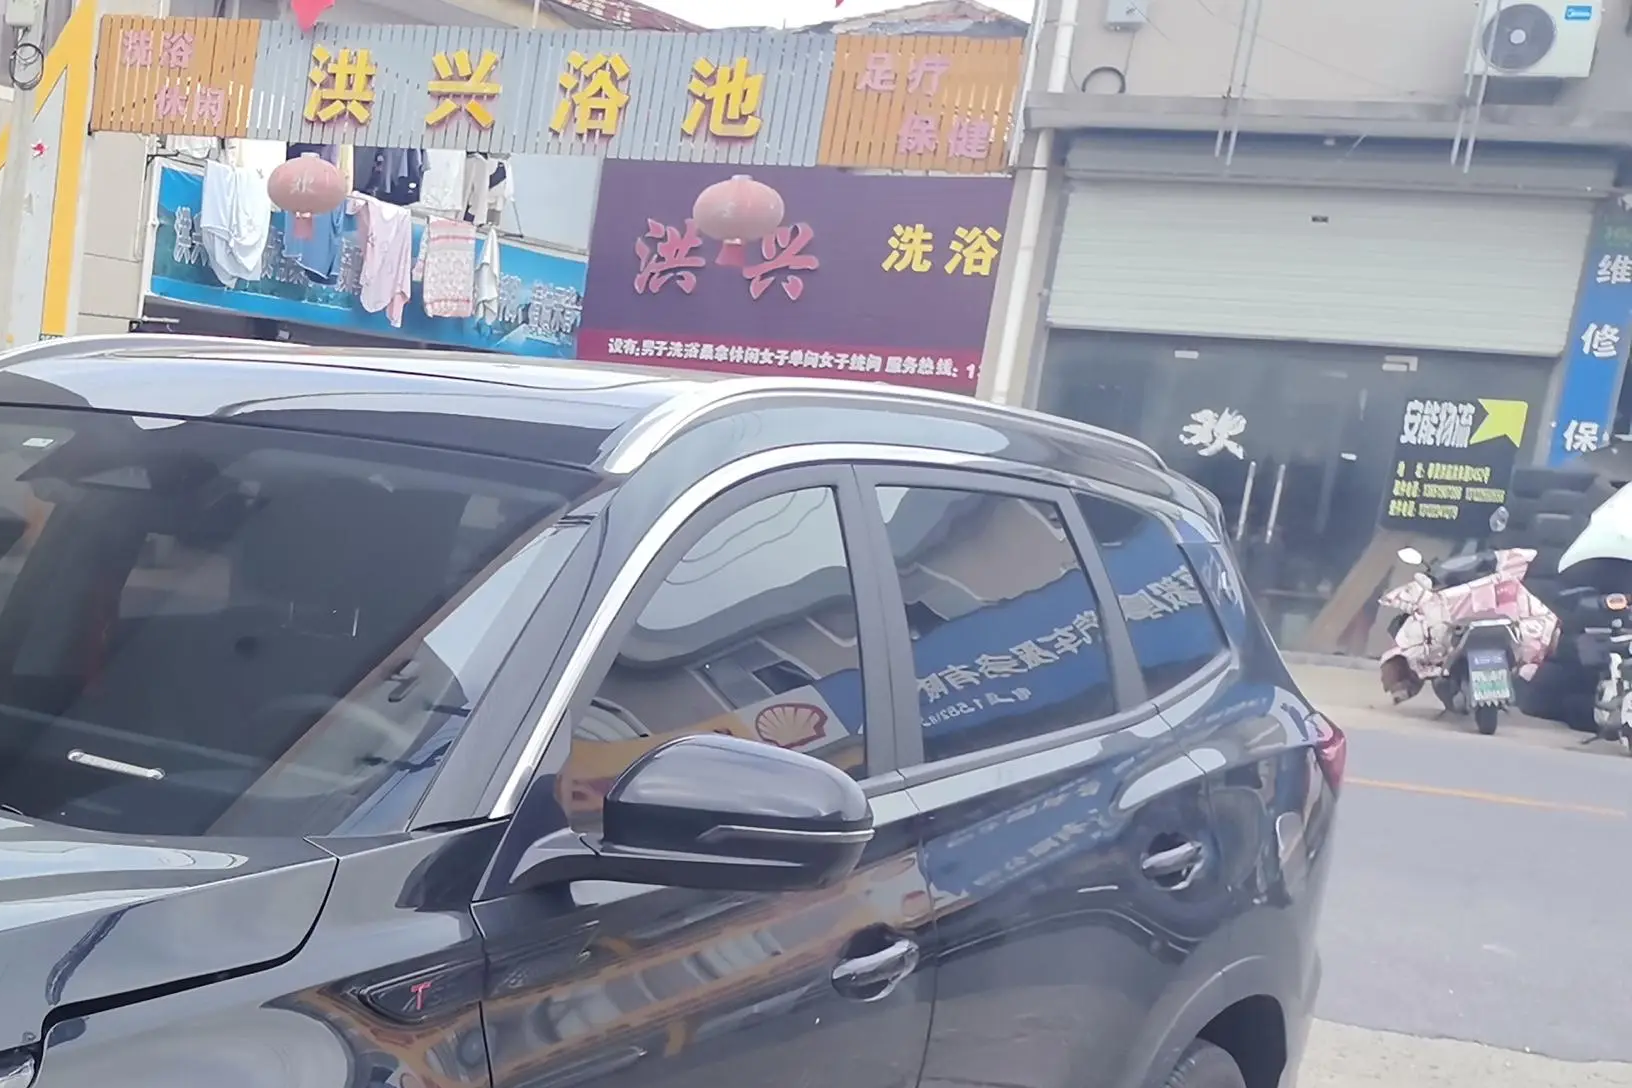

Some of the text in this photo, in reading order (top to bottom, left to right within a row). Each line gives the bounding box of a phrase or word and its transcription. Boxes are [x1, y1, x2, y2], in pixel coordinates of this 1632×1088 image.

[122, 29, 195, 69] 洗浴
[305, 45, 765, 138] 洪兴浴池
[857, 53, 950, 97] 足疗
[155, 86, 226, 127] 休闲
[897, 114, 990, 160] 保健
[633, 217, 819, 301] 洪兴
[881, 223, 1002, 277] 洗浴
